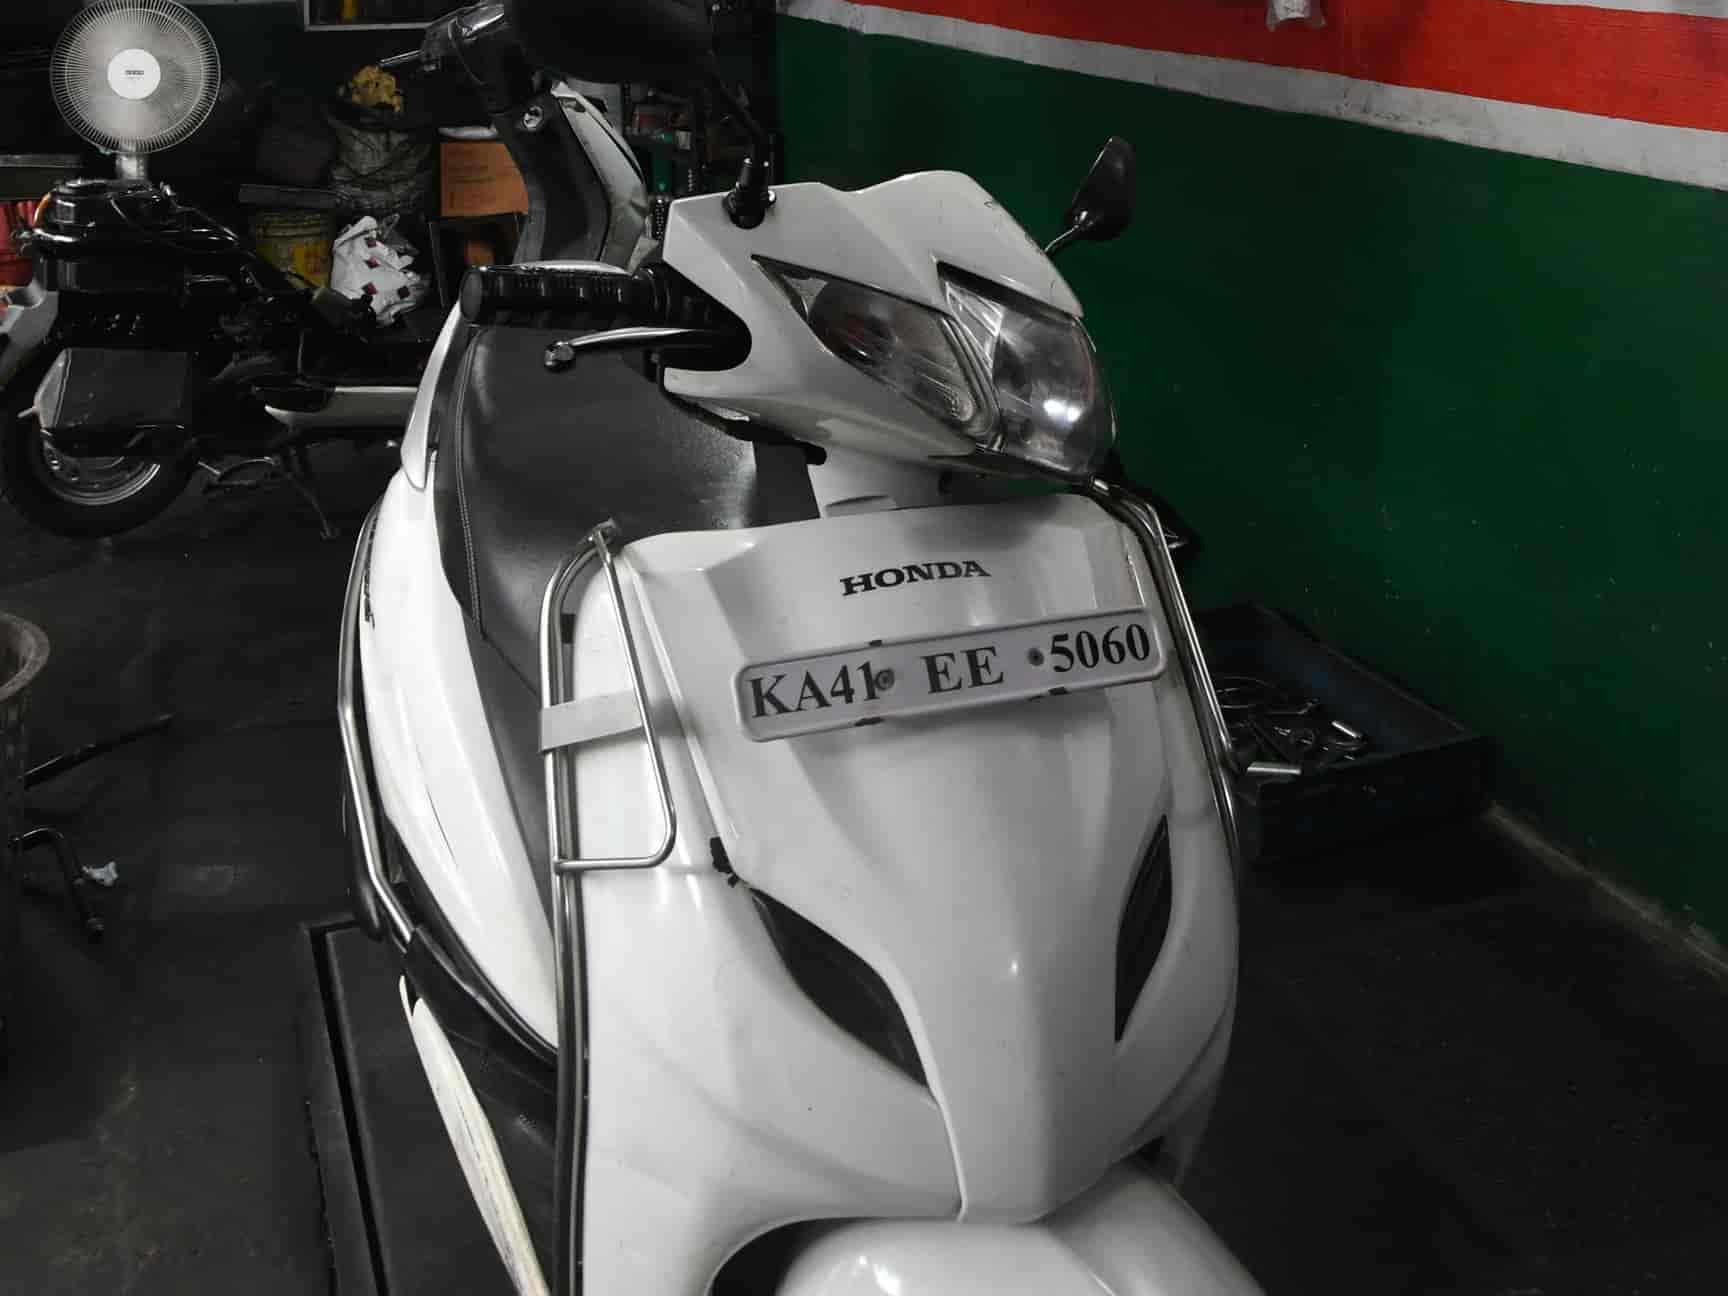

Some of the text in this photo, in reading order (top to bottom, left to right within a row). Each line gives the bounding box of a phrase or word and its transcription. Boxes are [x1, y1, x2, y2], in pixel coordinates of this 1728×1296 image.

[839, 559, 991, 596] HONDA
[747, 622, 1151, 718] KA41 EE 5060
